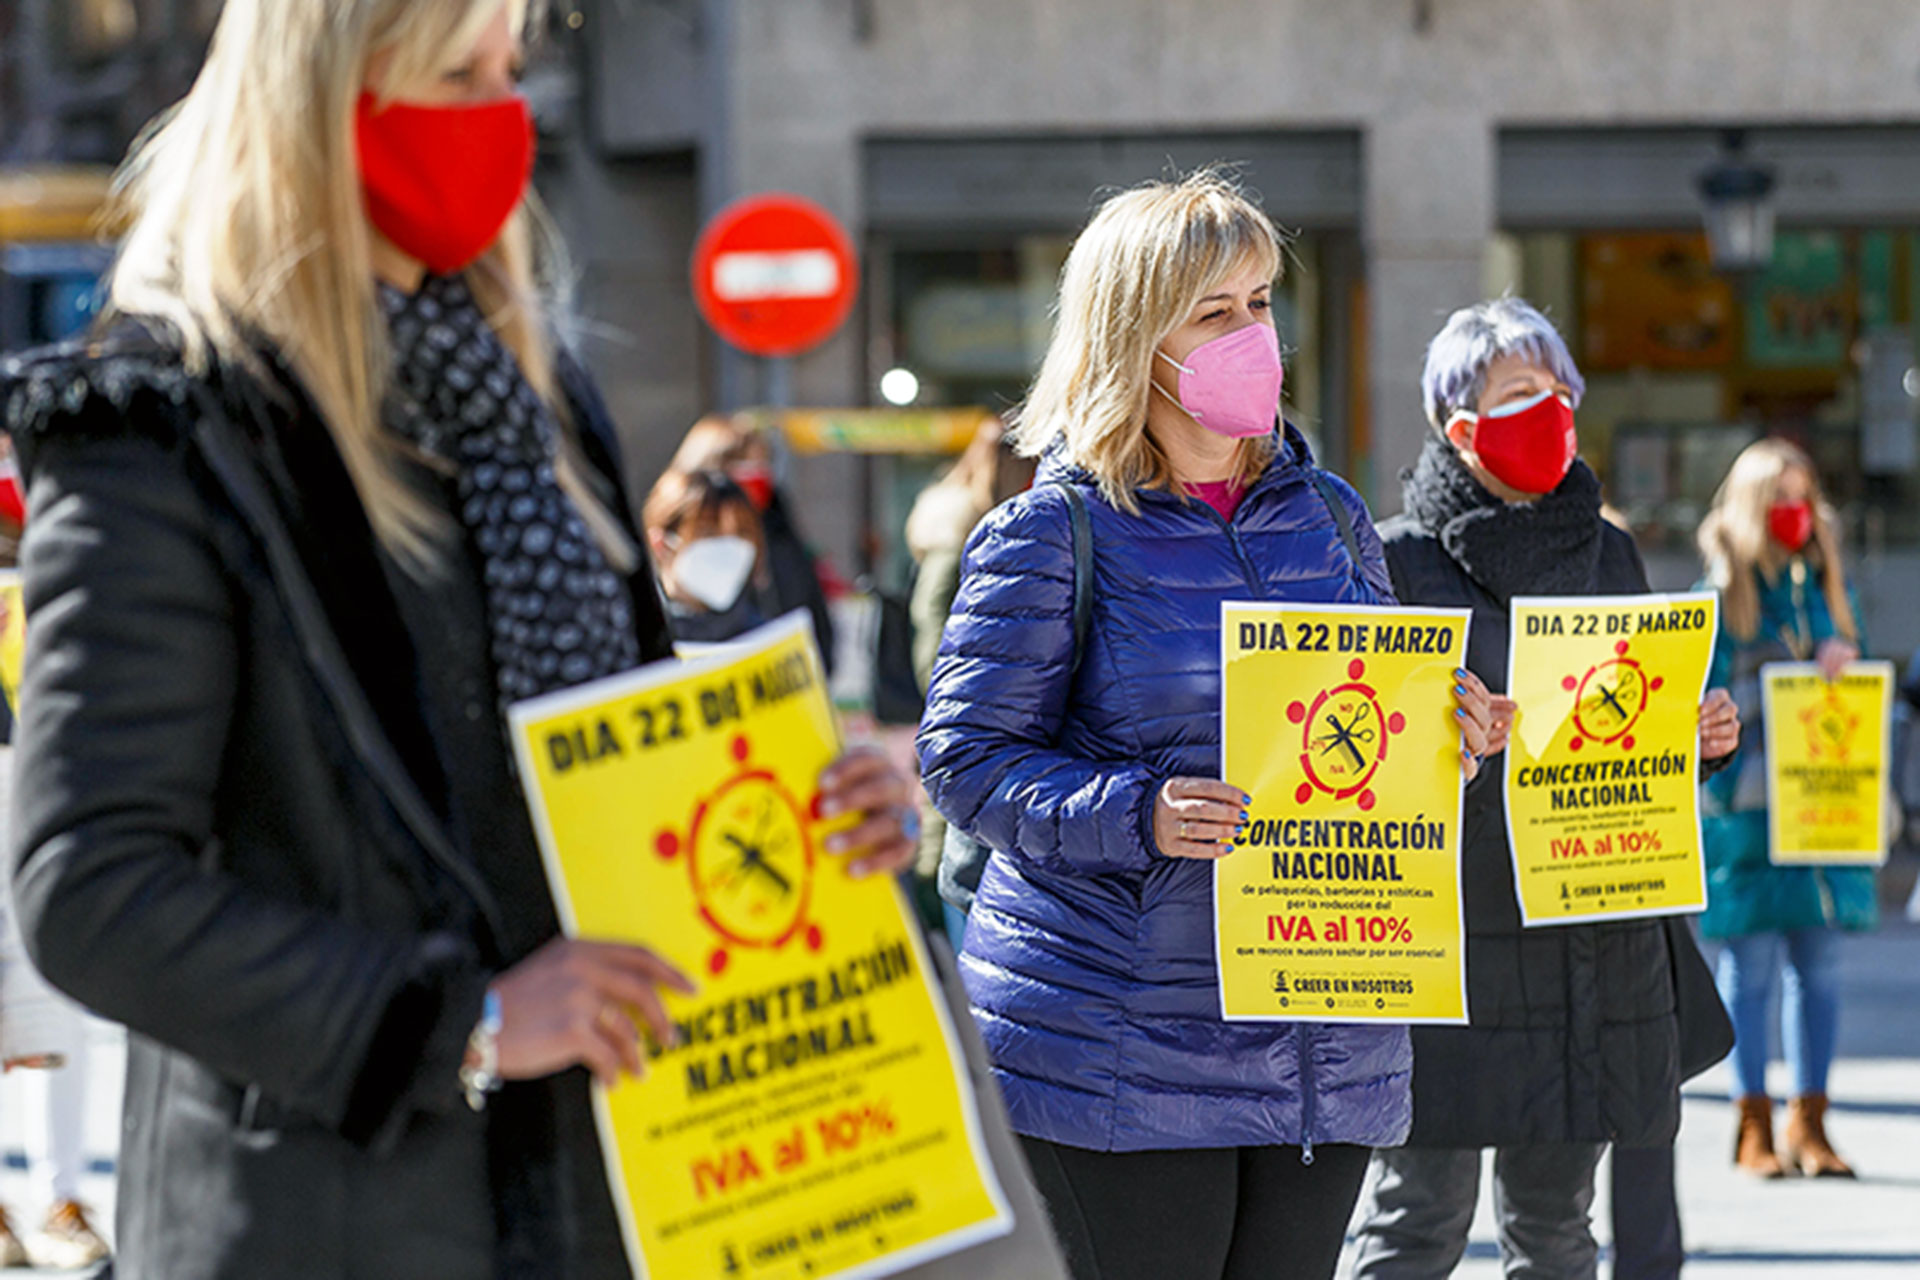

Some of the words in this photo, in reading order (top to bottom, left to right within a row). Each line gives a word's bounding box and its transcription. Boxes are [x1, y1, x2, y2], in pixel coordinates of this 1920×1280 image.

[1526, 615, 1564, 636] DIA
[1572, 614, 1598, 635] 22
[1606, 613, 1631, 634] DE
[1637, 608, 1706, 634] MARZO
[1239, 623, 1288, 650] DIA
[1297, 624, 1329, 651] 22
[1338, 625, 1369, 651] DE
[1375, 627, 1453, 654] MARZO
[546, 720, 623, 772] DIA
[635, 701, 688, 746] 22
[1518, 749, 1686, 787] CONCENTRACIÓN
[1551, 783, 1652, 810] NACIONAL
[1550, 837, 1588, 859] IVA
[1594, 834, 1613, 856] al
[1618, 830, 1662, 853] 10%
[1272, 853, 1402, 881] NACIONAL
[1268, 915, 1317, 942] IVA
[1324, 915, 1348, 942] al
[1355, 916, 1413, 943] 10%
[1294, 978, 1331, 993] CREER
[1333, 979, 1349, 993] EN
[1351, 979, 1414, 994] NOSOTROS
[686, 1012, 876, 1097] NACIONAL
[690, 1146, 763, 1202] IVA
[816, 1096, 896, 1155] 10%
